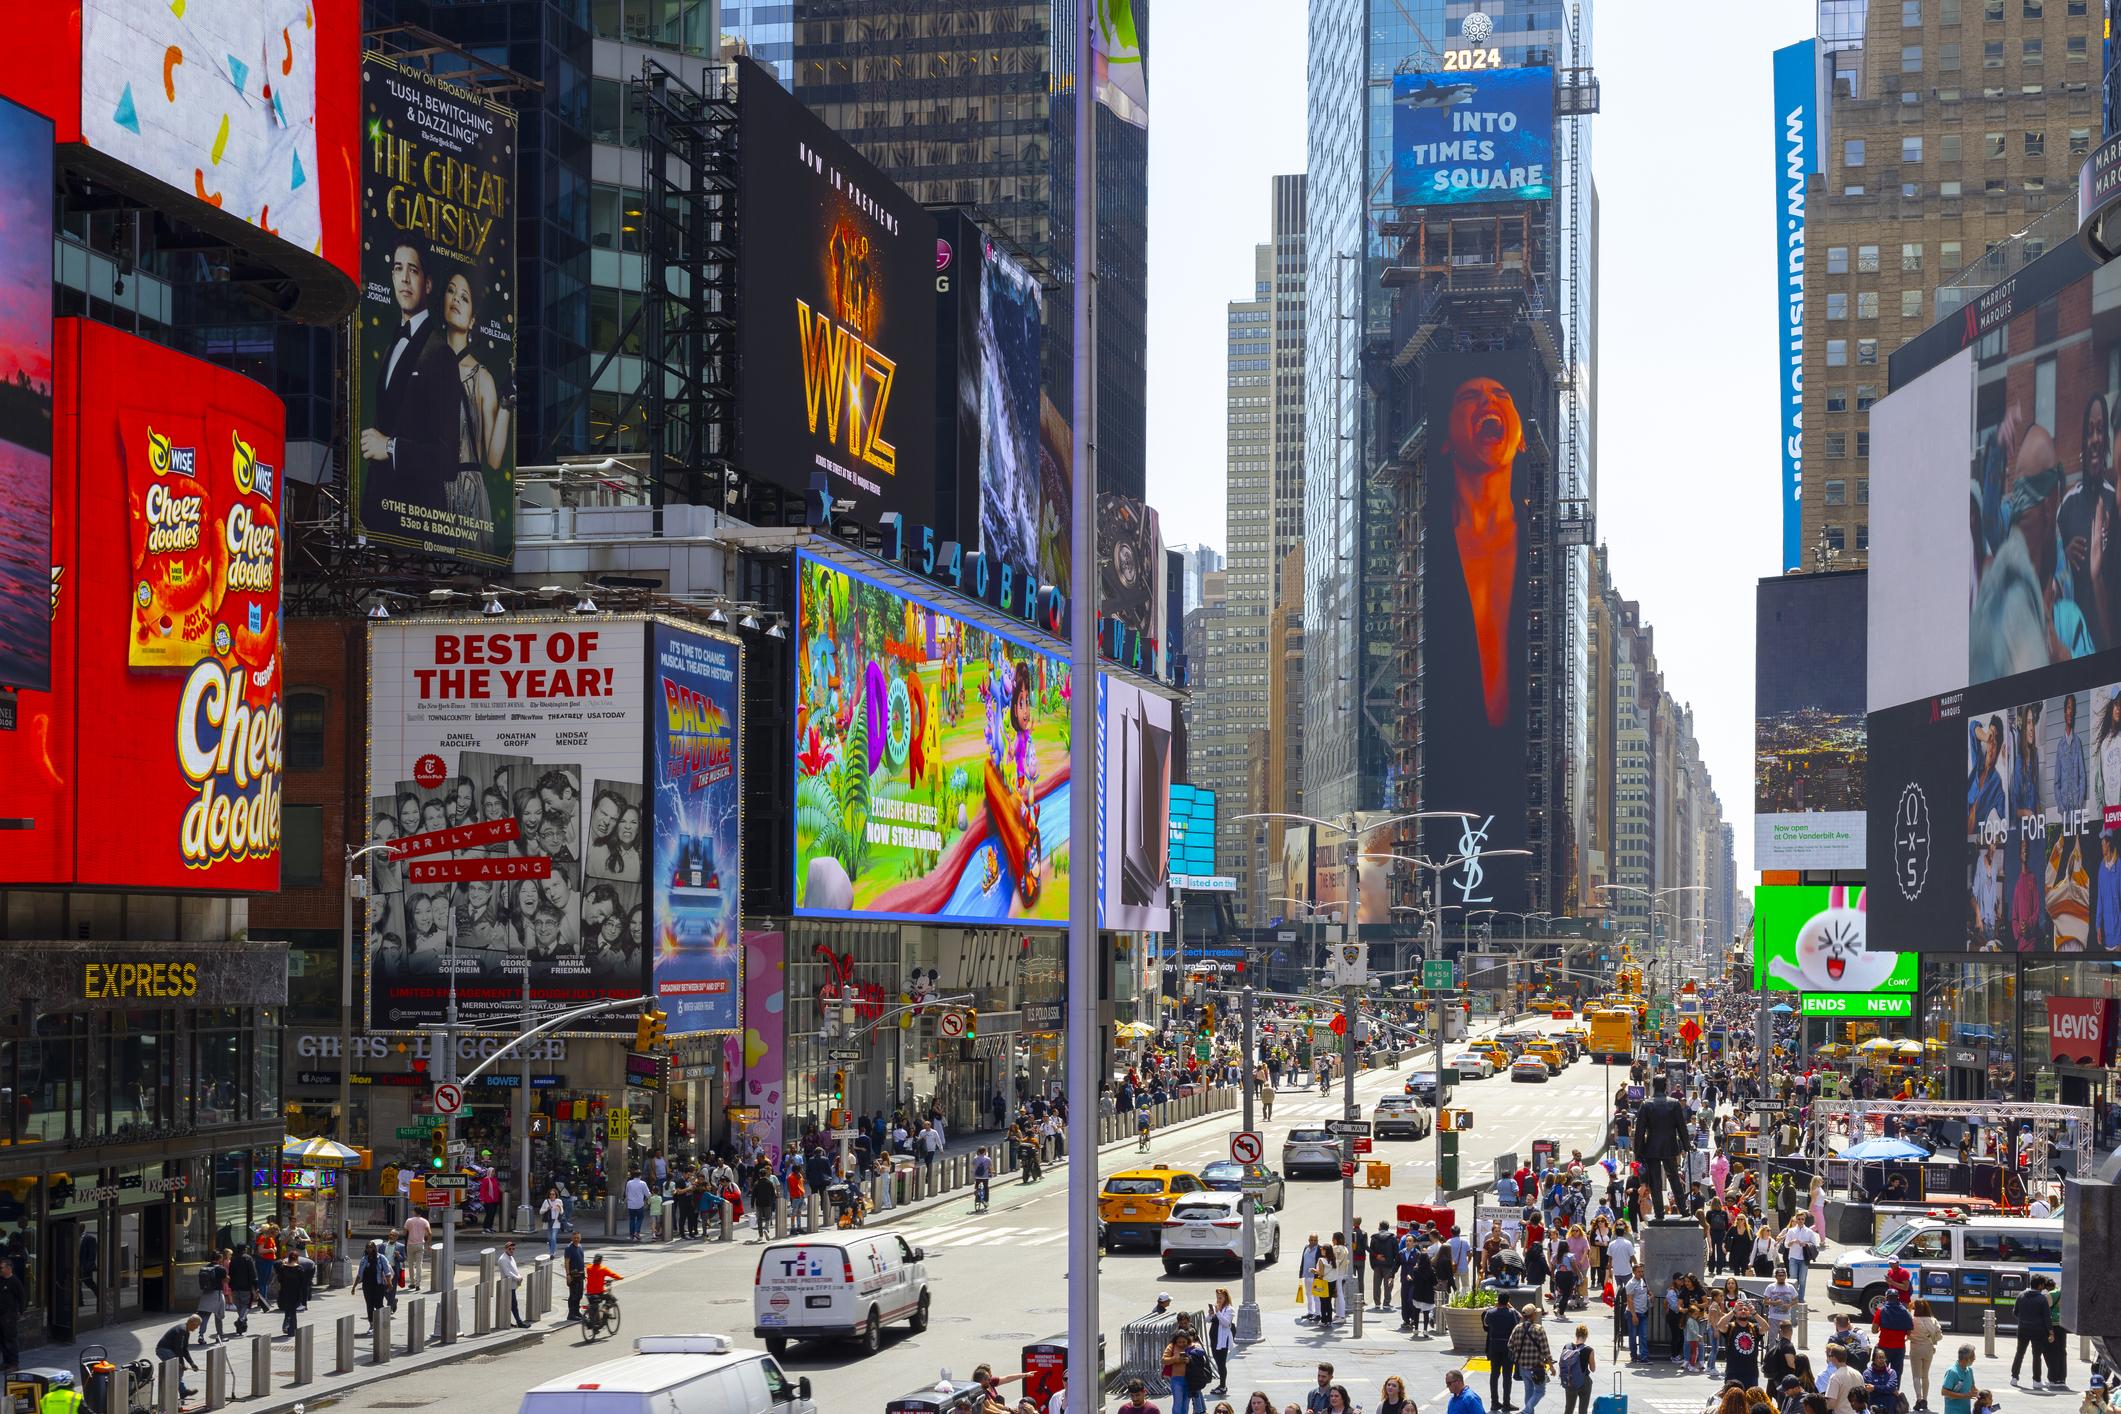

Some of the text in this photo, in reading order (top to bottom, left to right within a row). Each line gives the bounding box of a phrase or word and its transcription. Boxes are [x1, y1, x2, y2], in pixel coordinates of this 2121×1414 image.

[1443, 48, 1501, 71] 2024
[400, 64, 483, 106] NOW ON BROADWAY
[407, 106, 415, 121] &
[425, 95, 493, 134] BEWITCHING
[1453, 111, 1517, 132] INTO
[1413, 140, 1494, 165] TIMES
[370, 130, 509, 219] THE GREAT
[1433, 164, 1543, 191] SQUARE
[800, 142, 898, 236] NOW IN PREVIEWS
[387, 185, 493, 256] GATSBY
[430, 244, 477, 266] A NEW MUSICAL
[367, 291, 391, 305] JORDAN
[368, 282, 391, 294] JEREMY
[1980, 279, 2017, 312] MARRIOTT
[491, 320, 501, 330] EVA
[1980, 300, 2013, 330] MARQUIS
[480, 326, 511, 342] NOBLEZADA
[797, 298, 896, 476] WIZ
[170, 448, 194, 473] WISE
[255, 464, 273, 496] WISE
[146, 483, 201, 527] Cheez
[388, 500, 494, 533] THE BROADWAY THEATRE
[148, 522, 200, 555] doodles
[226, 503, 275, 560] Cheez
[400, 517, 478, 541] 53RD & BROADWAY
[433, 544, 455, 555] COMPANY
[893, 513, 989, 598] 1540
[227, 552, 274, 593] doodles
[184, 608, 201, 627] HOT
[435, 631, 599, 665] BEST OF
[681, 643, 726, 666] TIME TO CHANGE
[660, 653, 733, 683] MUSICAL THEATER HISTORY
[414, 668, 614, 700] THE YEAR!
[540, 701, 568, 709] Washington
[662, 676, 731, 736] BACK
[1941, 693, 1964, 706] MARRIOTT
[1941, 706, 1961, 717] MARQUIS
[178, 657, 282, 790] Cheez
[496, 732, 537, 740] JONATHAN
[555, 731, 588, 739] LINDSAY
[866, 658, 943, 790] DORA
[668, 736, 731, 774] TO FUTURE
[666, 760, 682, 780] THE
[698, 767, 731, 787] THE MUSICAL
[180, 775, 281, 870] doodles
[871, 796, 938, 827] EXCLUSIVE NEW SERIES
[489, 822, 513, 837] WE
[867, 822, 942, 851] NOW STREAMING
[1774, 824, 1809, 834] Now open
[1799, 831, 1834, 840] Vanderbilt
[1836, 830, 1851, 839] Ave.
[1978, 808, 2090, 845] TOPS FOR LIFE
[414, 862, 544, 878] ROLL ALONG
[1453, 814, 1496, 903] YSL
[85, 962, 197, 998] EXPRESS
[661, 984, 681, 992] BROADWAY
[390, 988, 434, 999] LIMITED
[1868, 999, 1902, 1011] NEW
[1036, 1007, 1047, 1020] POLO
[310, 1075, 331, 1084] Apple
[487, 1076, 520, 1087] BOWER
[686, 1068, 702, 1078] SONY
[611, 1110, 619, 1135] ATM
